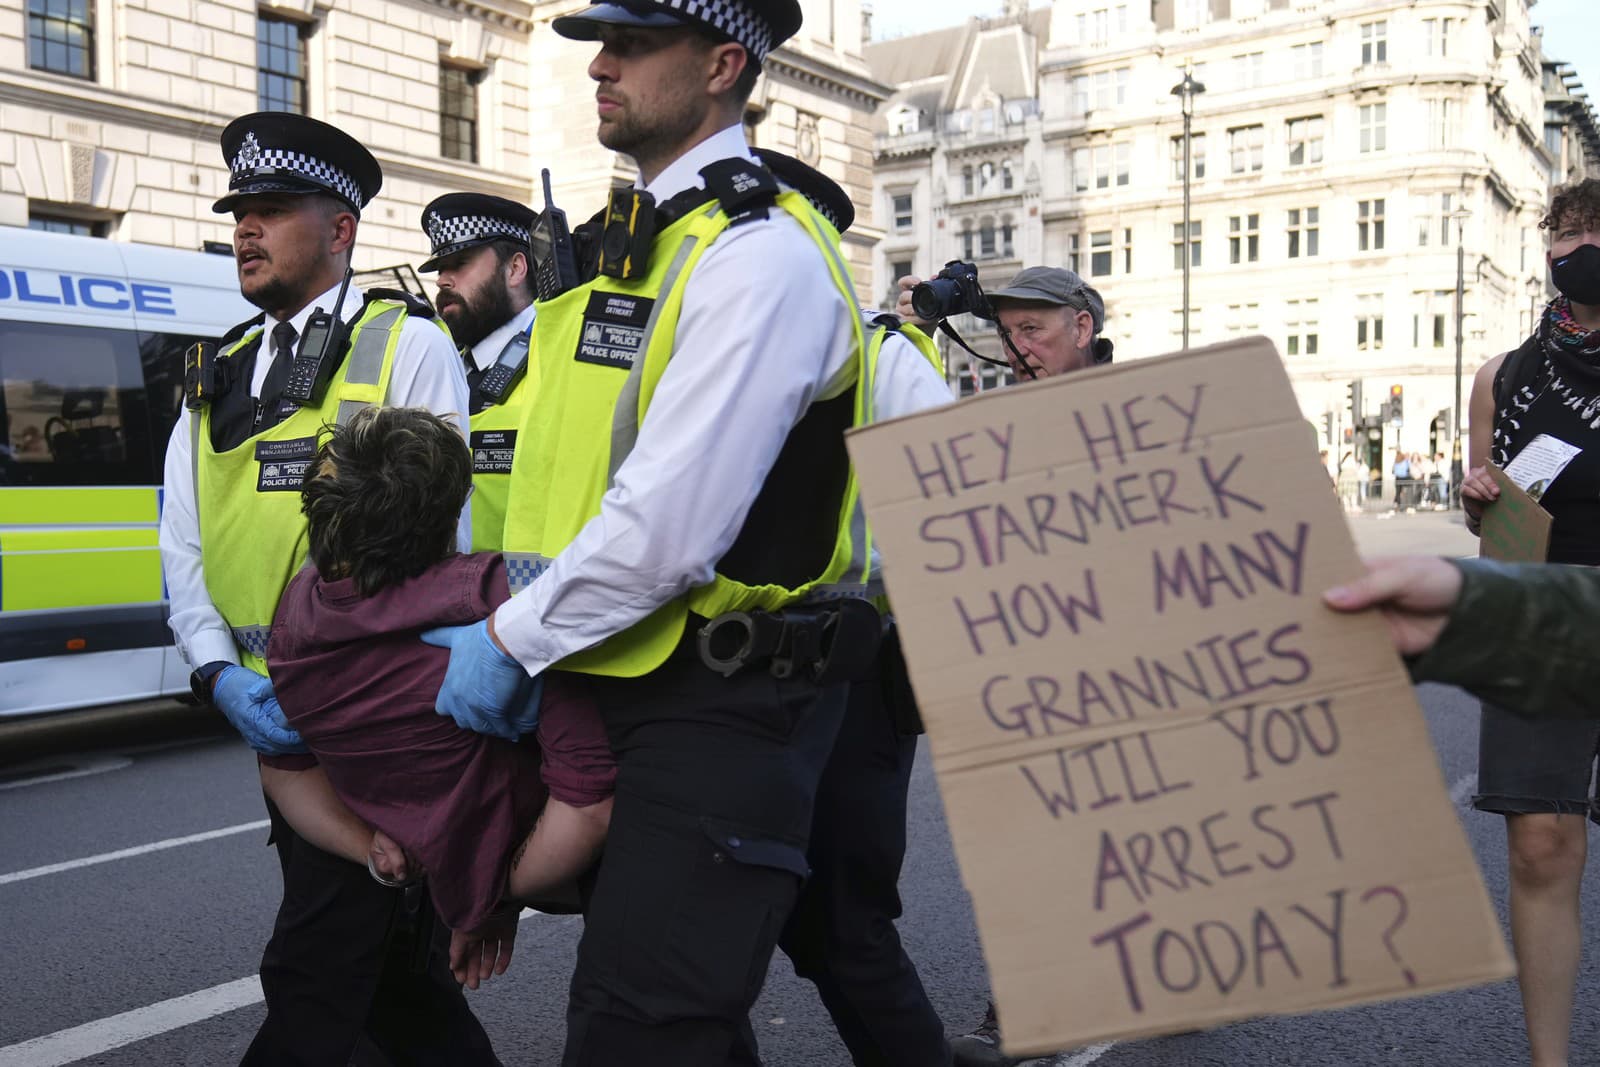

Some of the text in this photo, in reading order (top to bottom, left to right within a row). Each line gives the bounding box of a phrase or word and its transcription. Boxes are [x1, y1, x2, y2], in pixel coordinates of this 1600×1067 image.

[0, 270, 176, 316] LICE
[581, 345, 638, 361] POLICE OFFICE
[609, 334, 637, 346] POLICE
[262, 479, 287, 487] POLICE
[269, 442, 305, 450] CONSTABLE
[952, 521, 1310, 655] HOW MANY
[981, 622, 1313, 737] GRANNIES
[1017, 698, 1341, 820] WILL YOU
[1092, 791, 1345, 912] ARREST
[1090, 885, 1417, 1014] TODAY?
